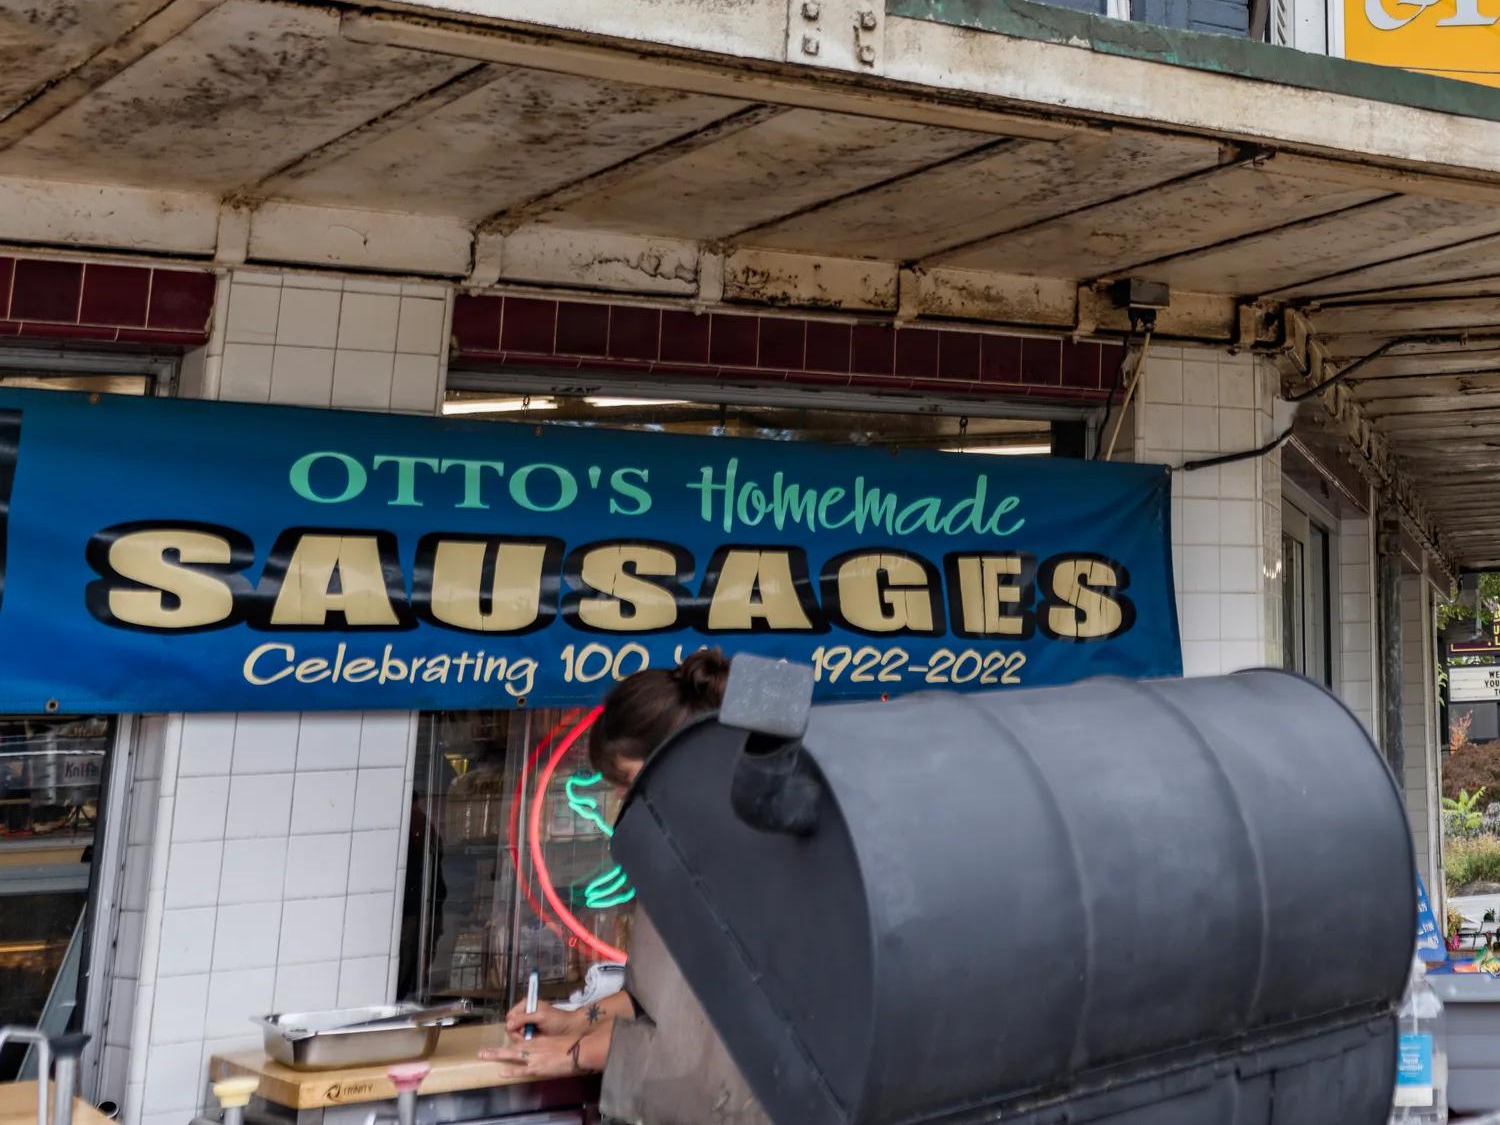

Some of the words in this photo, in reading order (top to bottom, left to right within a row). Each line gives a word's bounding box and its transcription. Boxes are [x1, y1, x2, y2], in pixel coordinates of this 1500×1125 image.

[289, 451, 653, 515] OTTO'S
[687, 458, 1025, 535] Homemade
[108, 529, 1123, 639] SAUSAGES
[243, 642, 538, 697] Celebrating
[560, 642, 650, 683] 100
[811, 646, 1026, 685] 1922-2022
[1484, 680, 1500, 688] YOU
[1488, 670, 1500, 679] WE
